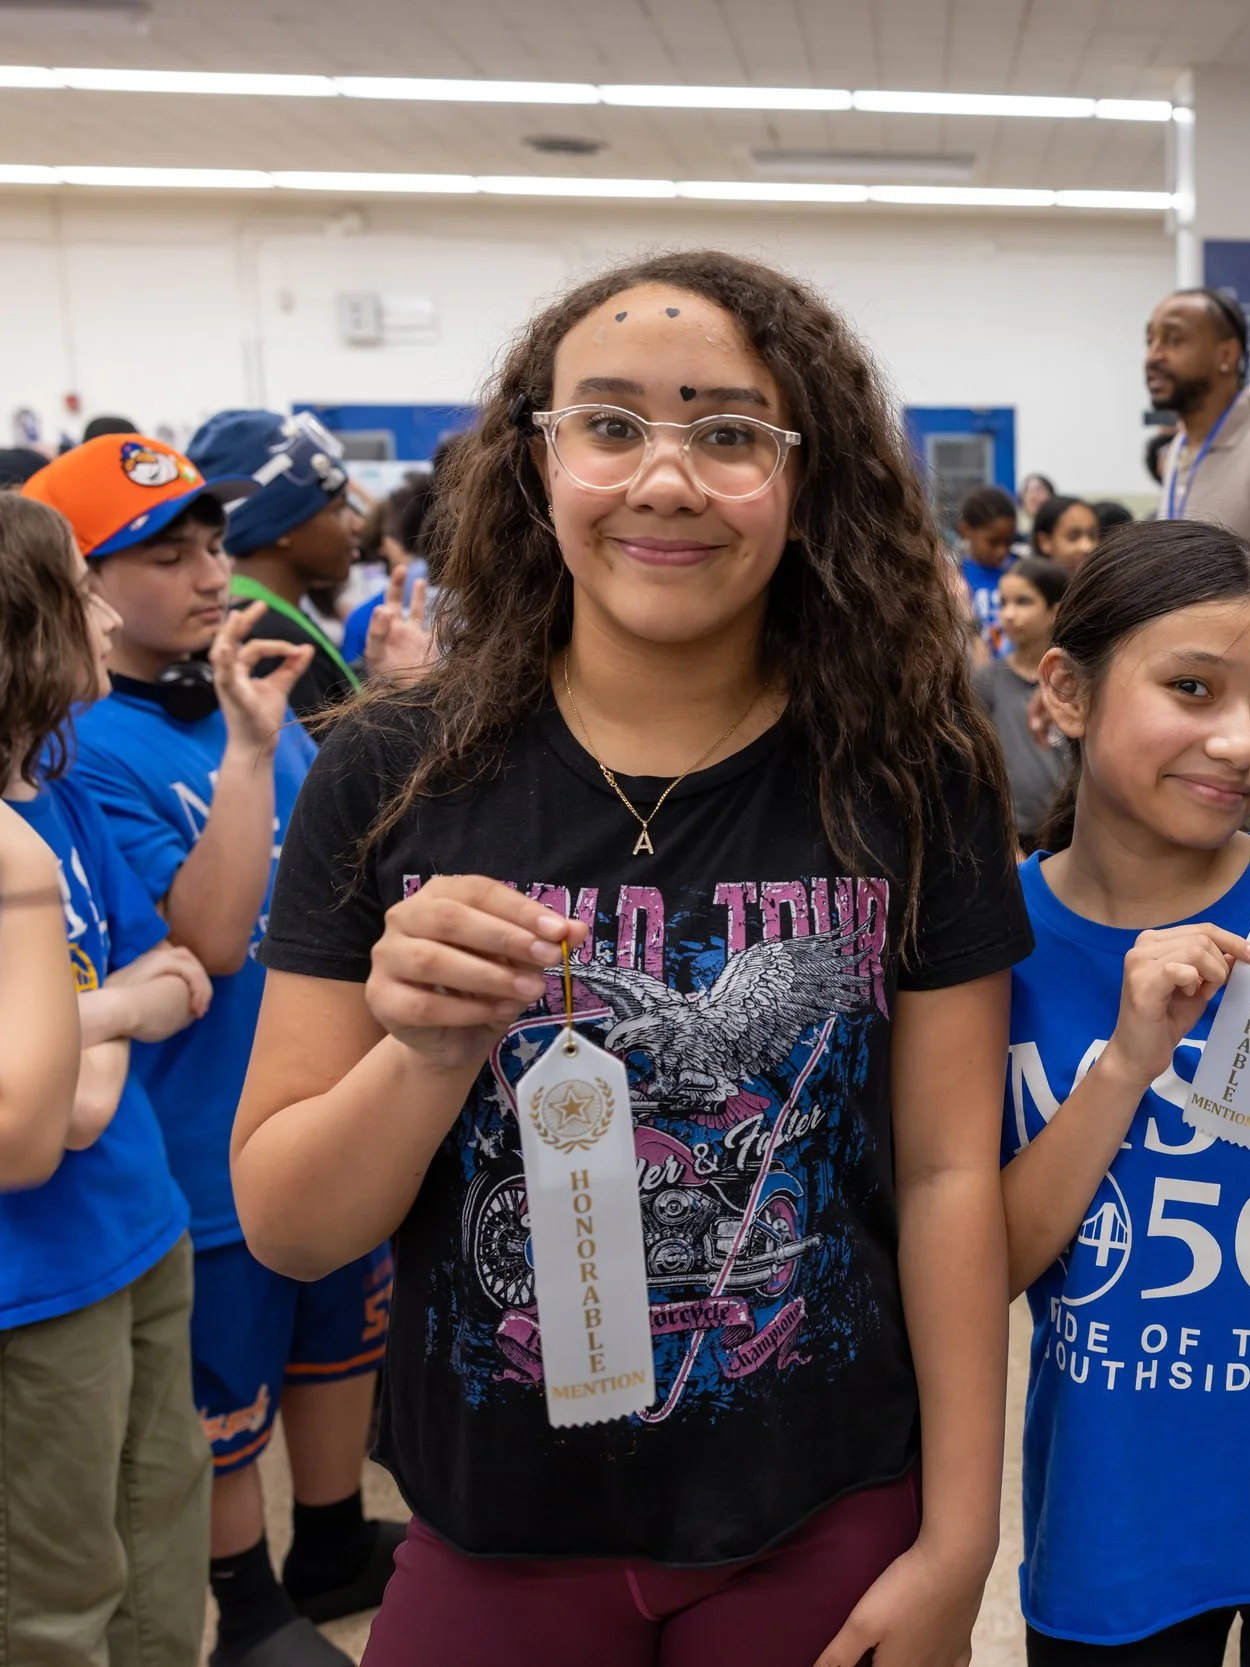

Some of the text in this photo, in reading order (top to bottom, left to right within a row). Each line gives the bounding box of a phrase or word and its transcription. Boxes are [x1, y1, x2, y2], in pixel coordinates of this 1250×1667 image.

[632, 829, 655, 856] A
[570, 1169, 606, 1374] HONORABLE
[649, 1300, 730, 1328] orcycle
[1140, 1324, 1201, 1355] OF
[551, 1370, 647, 1400] MENTION
